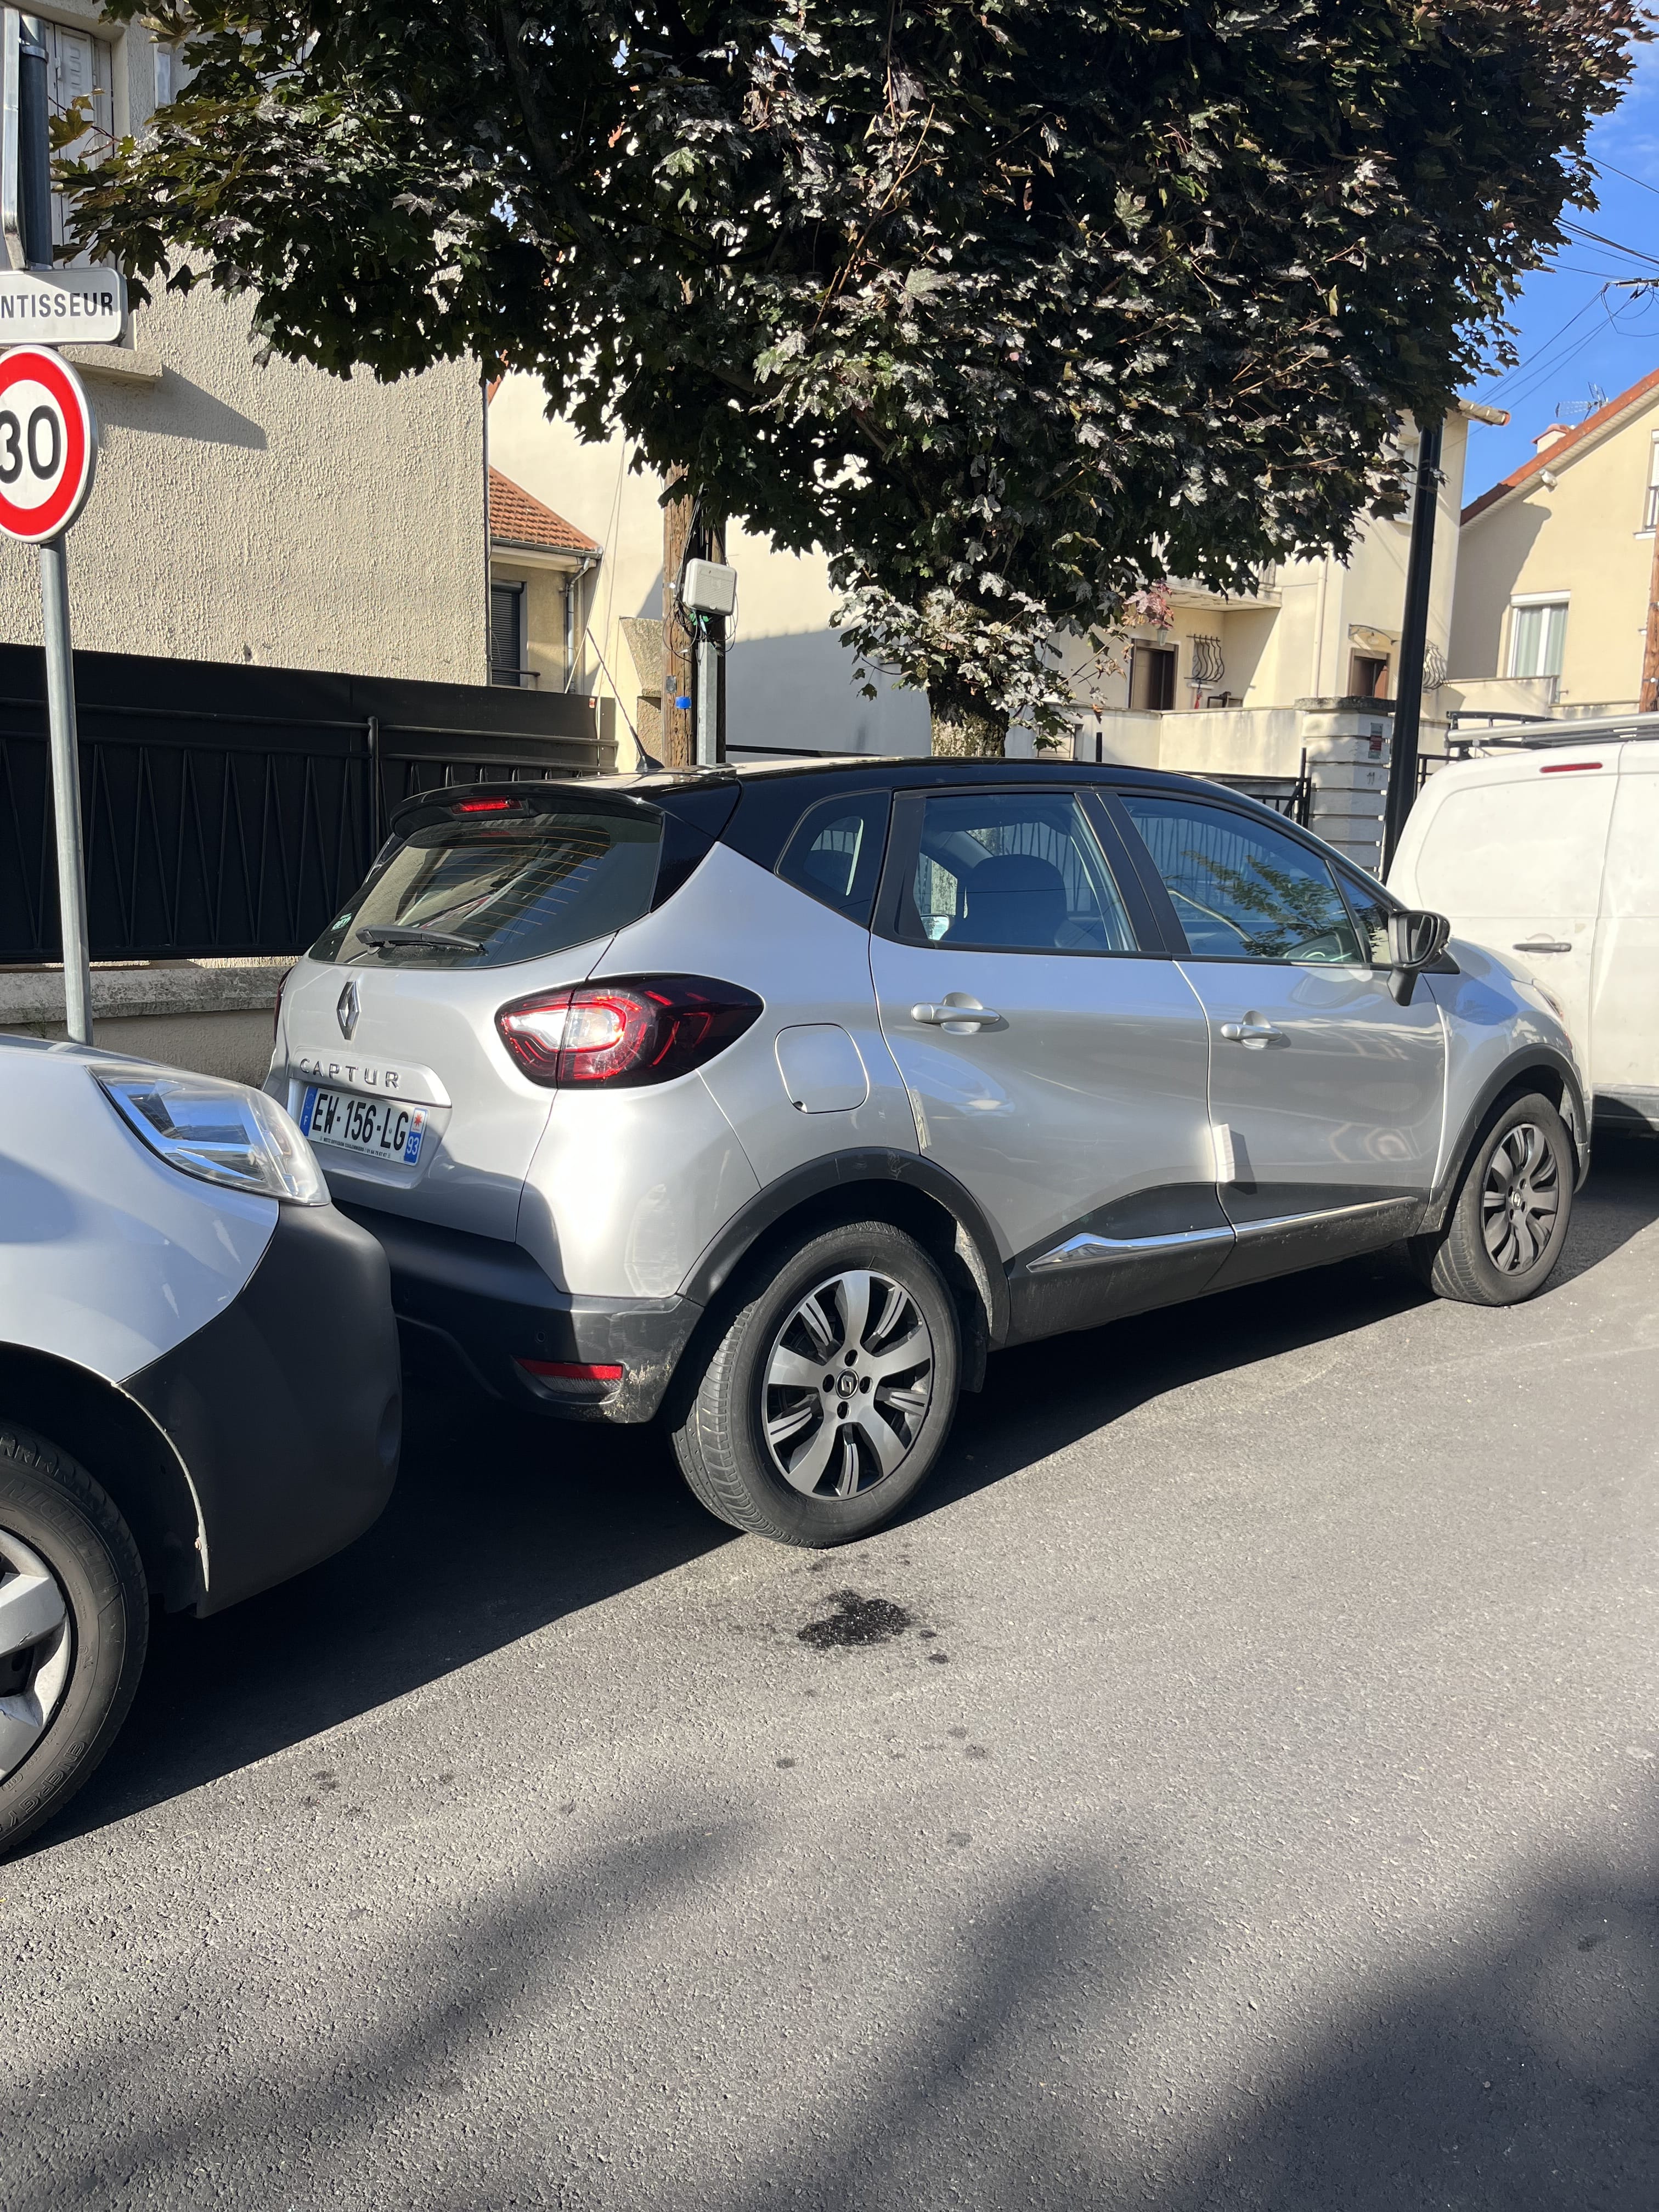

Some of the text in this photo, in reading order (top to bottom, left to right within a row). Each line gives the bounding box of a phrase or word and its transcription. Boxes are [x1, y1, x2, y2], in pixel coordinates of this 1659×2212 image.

[1, 292, 113, 318] NTISSEUR
[0, 405, 61, 484] 30
[300, 1058, 400, 1088] CAPTUR
[303, 1115, 308, 1125] F
[312, 1093, 409, 1151] EW-156-LG
[407, 1136, 420, 1155] 93
[1, 1479, 115, 1587] MICHELIN
[8, 1740, 86, 1827] ENERGY
